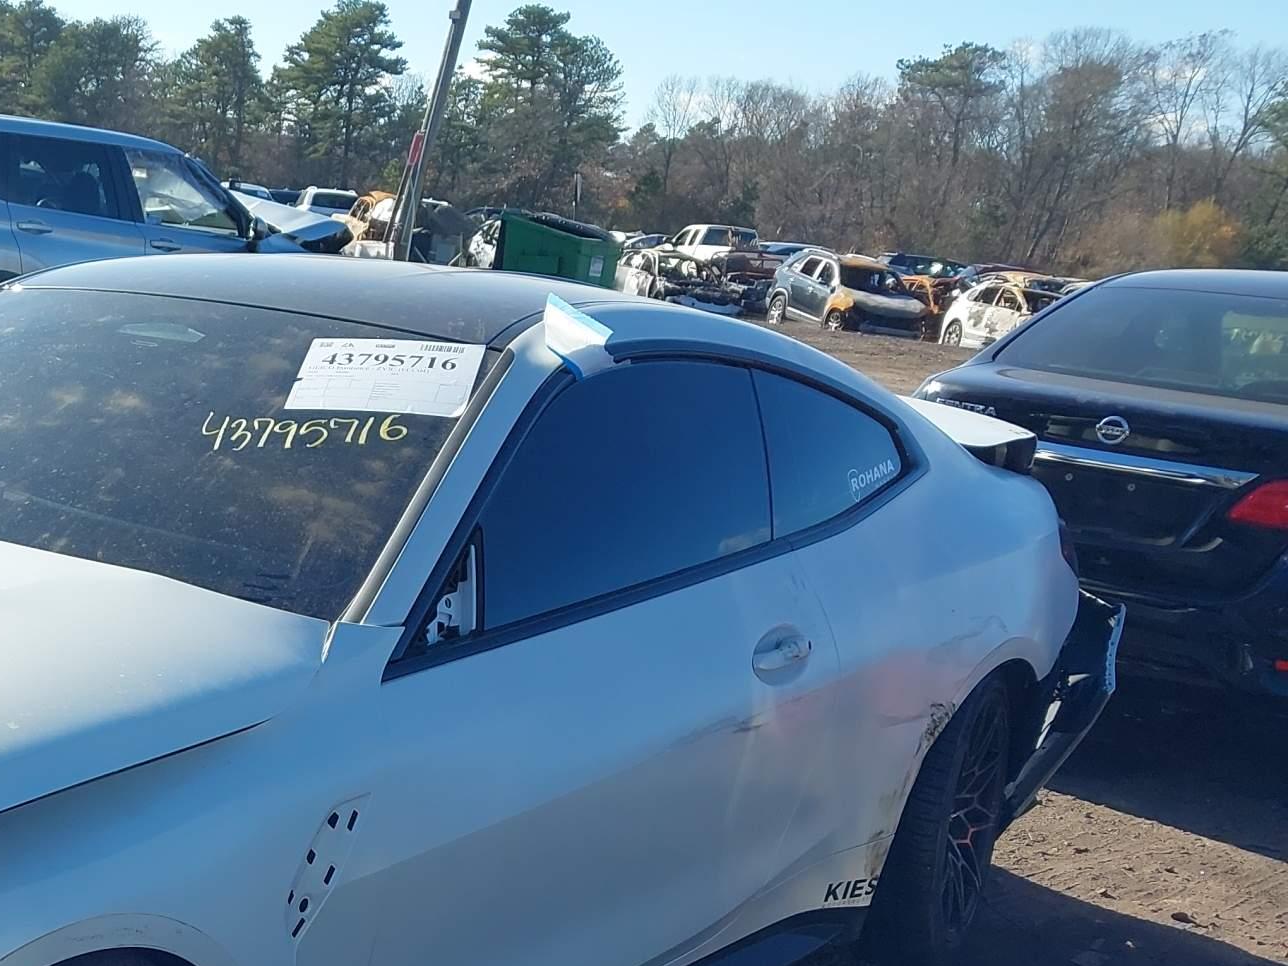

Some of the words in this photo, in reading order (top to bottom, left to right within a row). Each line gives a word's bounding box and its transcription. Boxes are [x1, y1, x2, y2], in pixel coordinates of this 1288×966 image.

[321, 352, 458, 371] 43795716
[202, 411, 407, 450] 43795716
[850, 459, 895, 492] ROHANA
